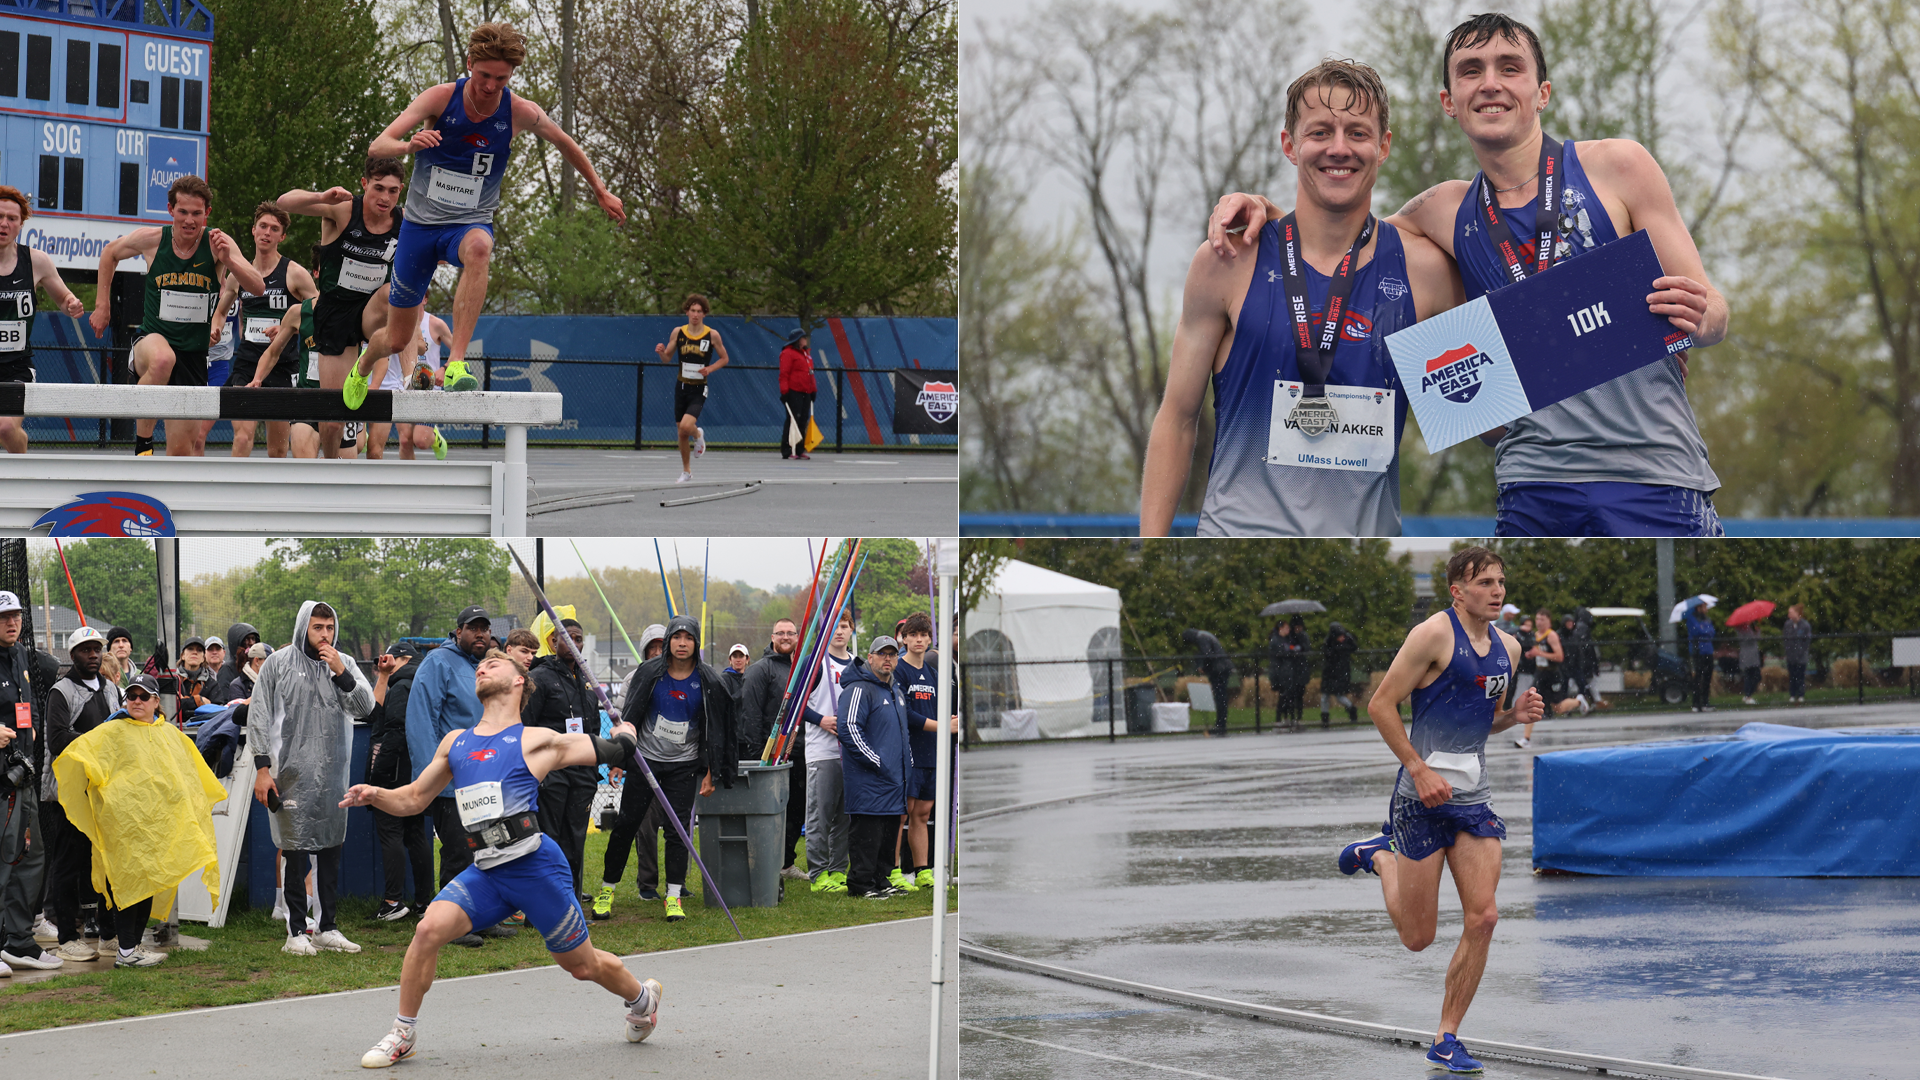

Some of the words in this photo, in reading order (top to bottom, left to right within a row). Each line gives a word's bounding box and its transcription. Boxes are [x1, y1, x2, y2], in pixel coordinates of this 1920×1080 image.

[144, 41, 203, 77] GUEST
[42, 121, 82, 155] SOG
[116, 128, 144, 156] QTR
[476, 155, 490, 174] 5
[1546, 156, 1555, 175] EAST
[436, 180, 475, 196] MASHTARE
[1545, 176, 1554, 211] AMERICA
[437, 196, 452, 204] UMass
[1486, 205, 1499, 225] EAST
[1285, 223, 1293, 241] EAST
[342, 242, 386, 258] BINGHAM
[1503, 240, 1519, 265] WHERE
[1538, 230, 1552, 260] RISE
[1286, 241, 1297, 276] AMERICA
[1339, 254, 1351, 278] EAST
[155, 272, 212, 291] VERMONT
[345, 271, 382, 283] ROSENBLATT
[21, 295, 30, 316] 6
[273, 296, 285, 309] 11
[1292, 295, 1307, 323] RISE
[1330, 296, 1343, 322] WHERE
[1567, 301, 1612, 337] 10K
[1297, 322, 1308, 348] WHERE
[1320, 321, 1337, 350] RISE
[702, 340, 708, 351] 7
[1666, 337, 1691, 354] RISE
[1421, 351, 1495, 394] AMERICA
[1438, 368, 1479, 396] EAST
[1328, 392, 1372, 401] Championship
[928, 402, 953, 411] EAST
[1292, 410, 1336, 420] AMERICA
[1300, 418, 1326, 426] EAST
[1342, 424, 1384, 437] AKKER
[1297, 453, 1332, 465] UMass
[1334, 457, 1368, 467] Lowell
[915, 692, 932, 700] EAST
[1488, 676, 1506, 697] 22
[658, 726, 684, 736] STELMACH
[462, 795, 498, 812] MUNROE
